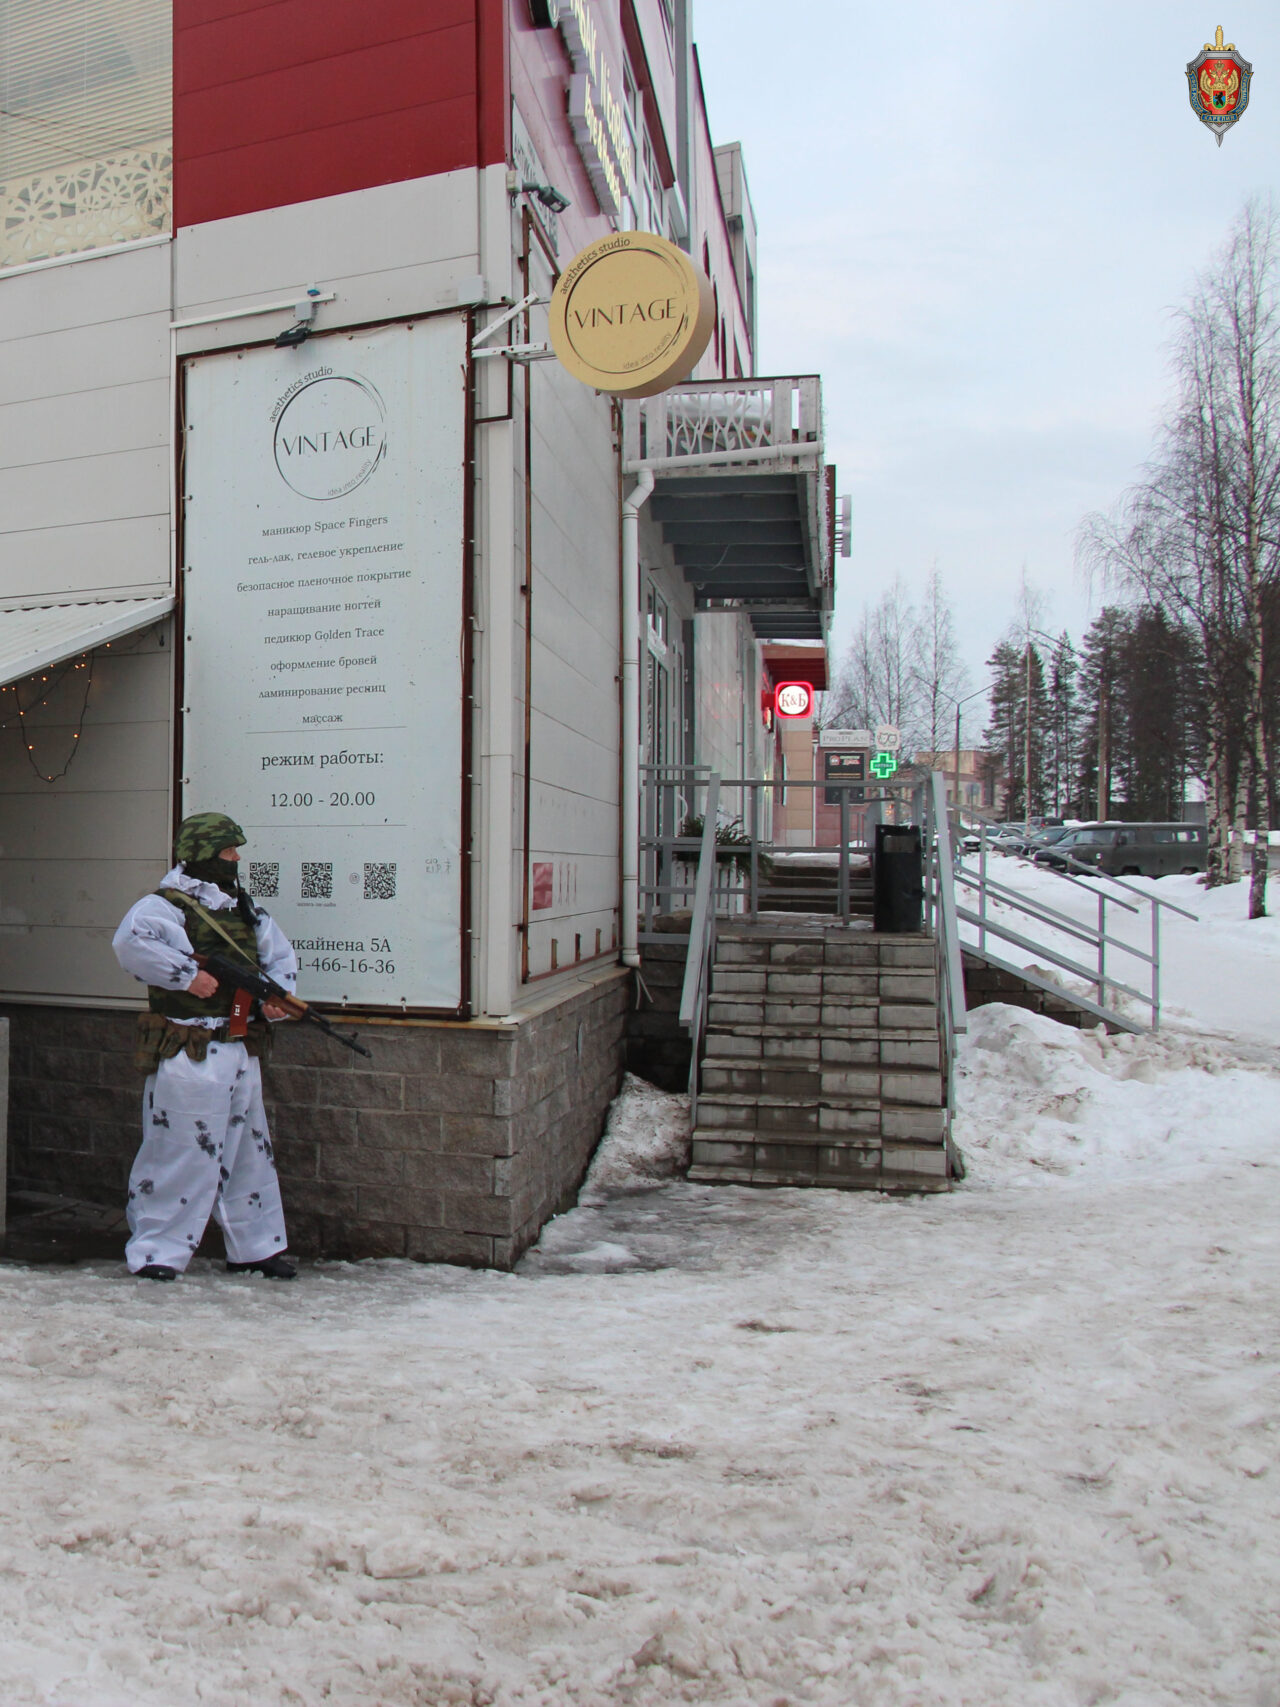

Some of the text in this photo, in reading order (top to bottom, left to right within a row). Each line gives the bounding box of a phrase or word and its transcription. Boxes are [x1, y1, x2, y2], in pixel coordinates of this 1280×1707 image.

[560, 237, 631, 295] aesthetics studio
[574, 297, 677, 329] VINTAGE
[270, 366, 333, 423] aesthetics studio
[283, 425, 376, 456] VINTAGE
[262, 516, 389, 537] маникюр Space Fingers
[248, 542, 404, 565] гель-лак, гелевое укрепление
[237, 569, 412, 593] безопасное пленочное покрытие
[267, 599, 381, 618] наращивание ногтей
[264, 627, 385, 645] педикюр Golden Trace
[270, 655, 377, 673] оформление бровей
[258, 683, 386, 700] ламинирование ресниц
[302, 713, 343, 724] массаж
[261, 750, 384, 770] режим работы:
[270, 792, 313, 808] 12.00
[329, 791, 375, 807] 20.00
[288, 938, 392, 953] икайнена 5А
[297, 957, 396, 974] 1-466-16-36
